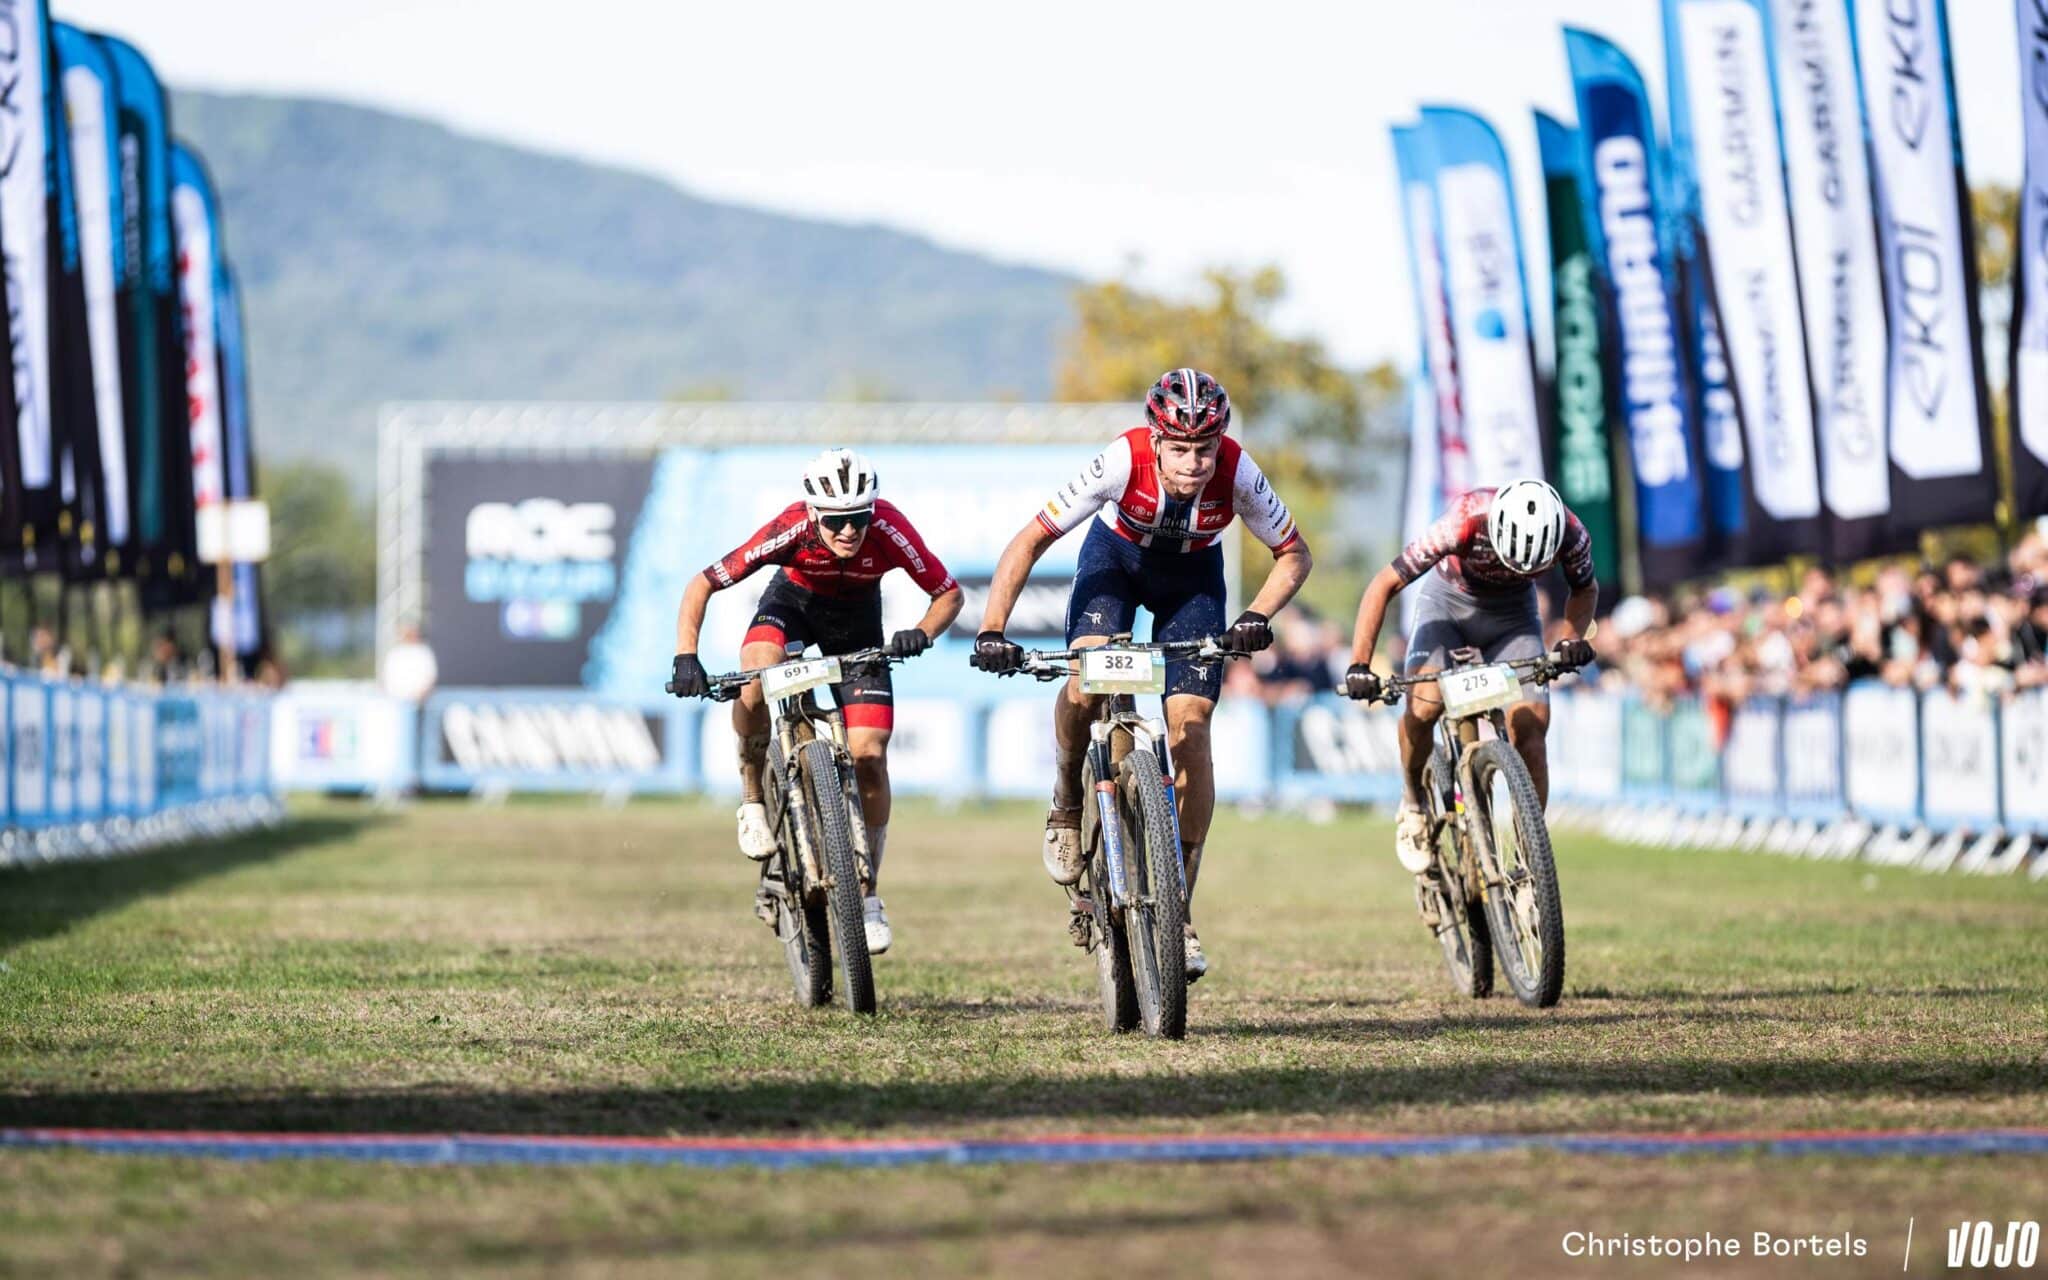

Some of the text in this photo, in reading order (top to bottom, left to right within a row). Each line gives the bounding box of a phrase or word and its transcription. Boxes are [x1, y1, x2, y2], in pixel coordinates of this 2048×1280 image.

[1595, 136, 1688, 487] SHIMANO
[1104, 655, 1134, 670] 382
[783, 664, 811, 679] 691
[1462, 673, 1489, 692] 275
